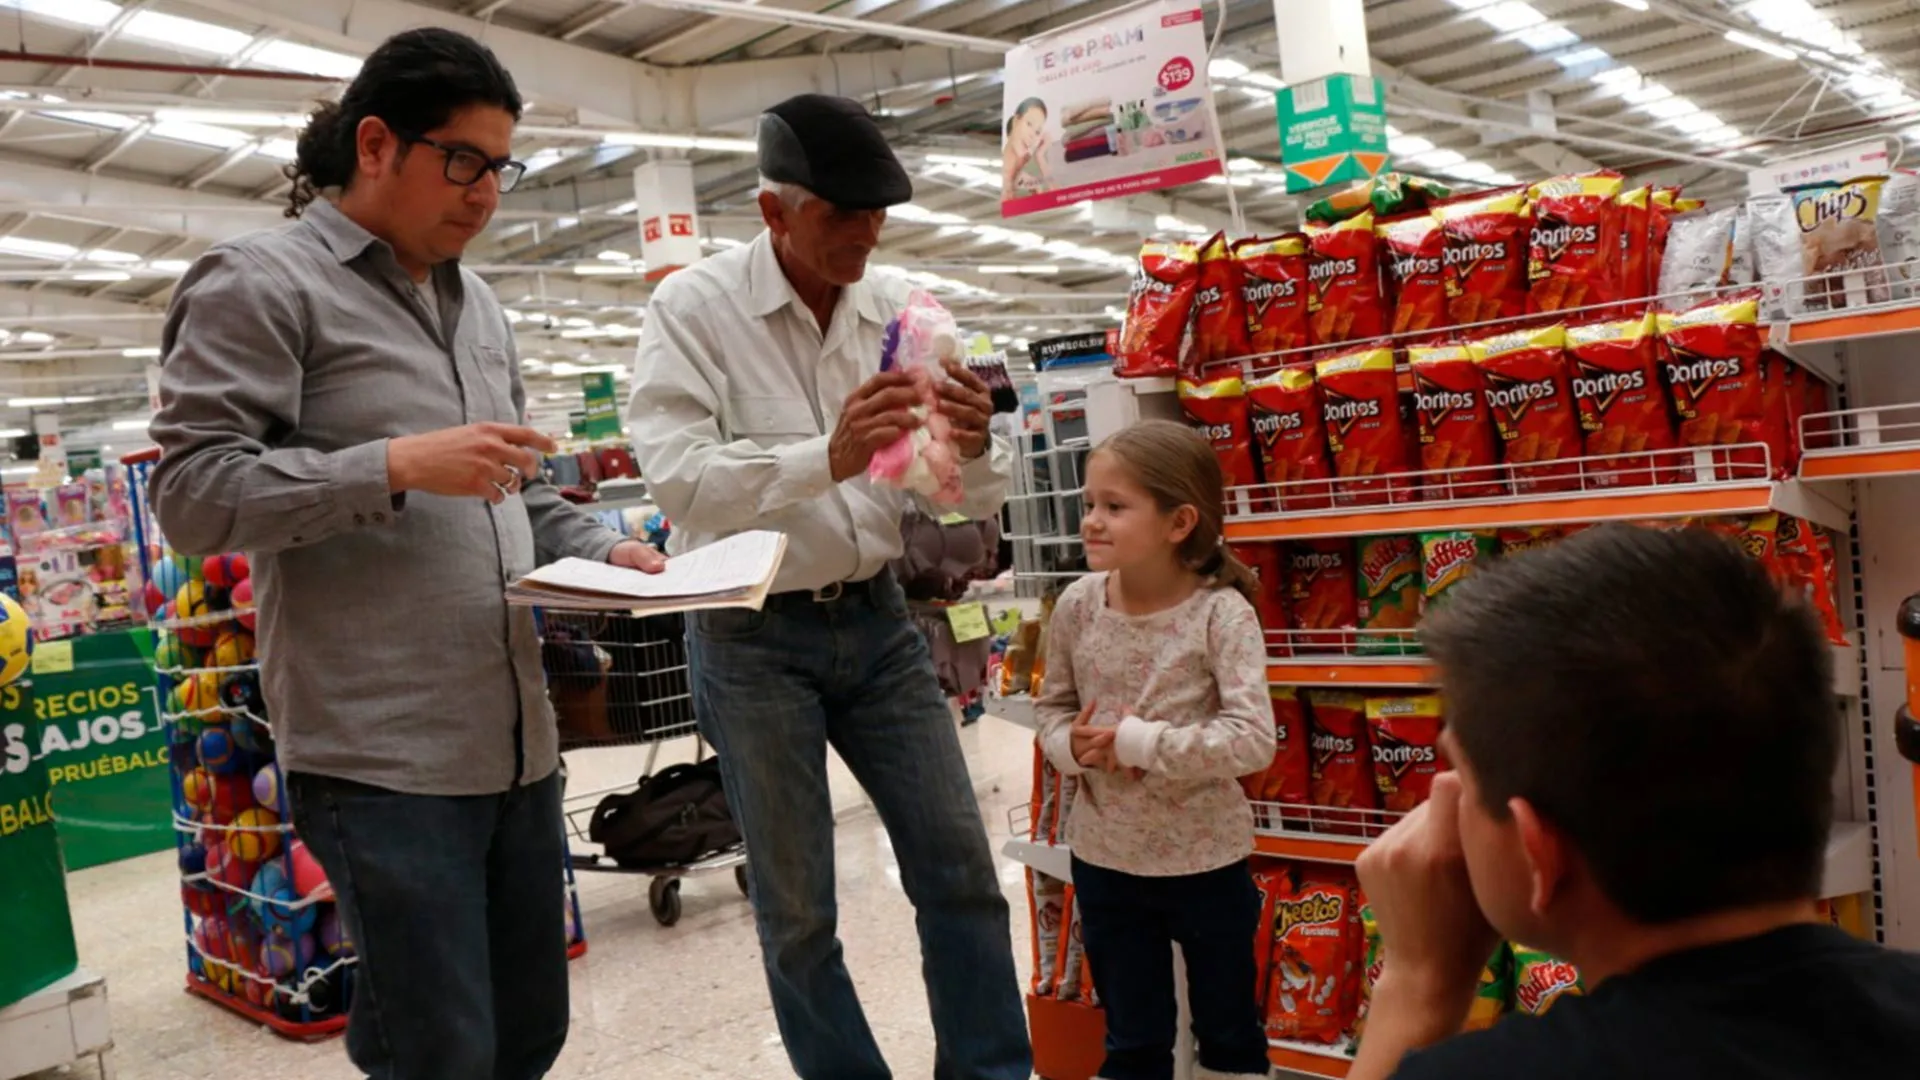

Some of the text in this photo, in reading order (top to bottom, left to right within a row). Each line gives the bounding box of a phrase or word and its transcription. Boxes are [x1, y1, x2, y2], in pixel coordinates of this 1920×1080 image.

[1161, 68, 1190, 85] $139
[1796, 184, 1867, 233] Chips
[1530, 225, 1596, 247] Doritos
[1572, 370, 1645, 398] Doritos
[1666, 357, 1740, 384] Doritos
[1485, 379, 1554, 408] Doritos
[34, 682, 140, 720] RECIOS
[40, 710, 146, 755] AJOS
[1516, 960, 1577, 1012] Ruffles
